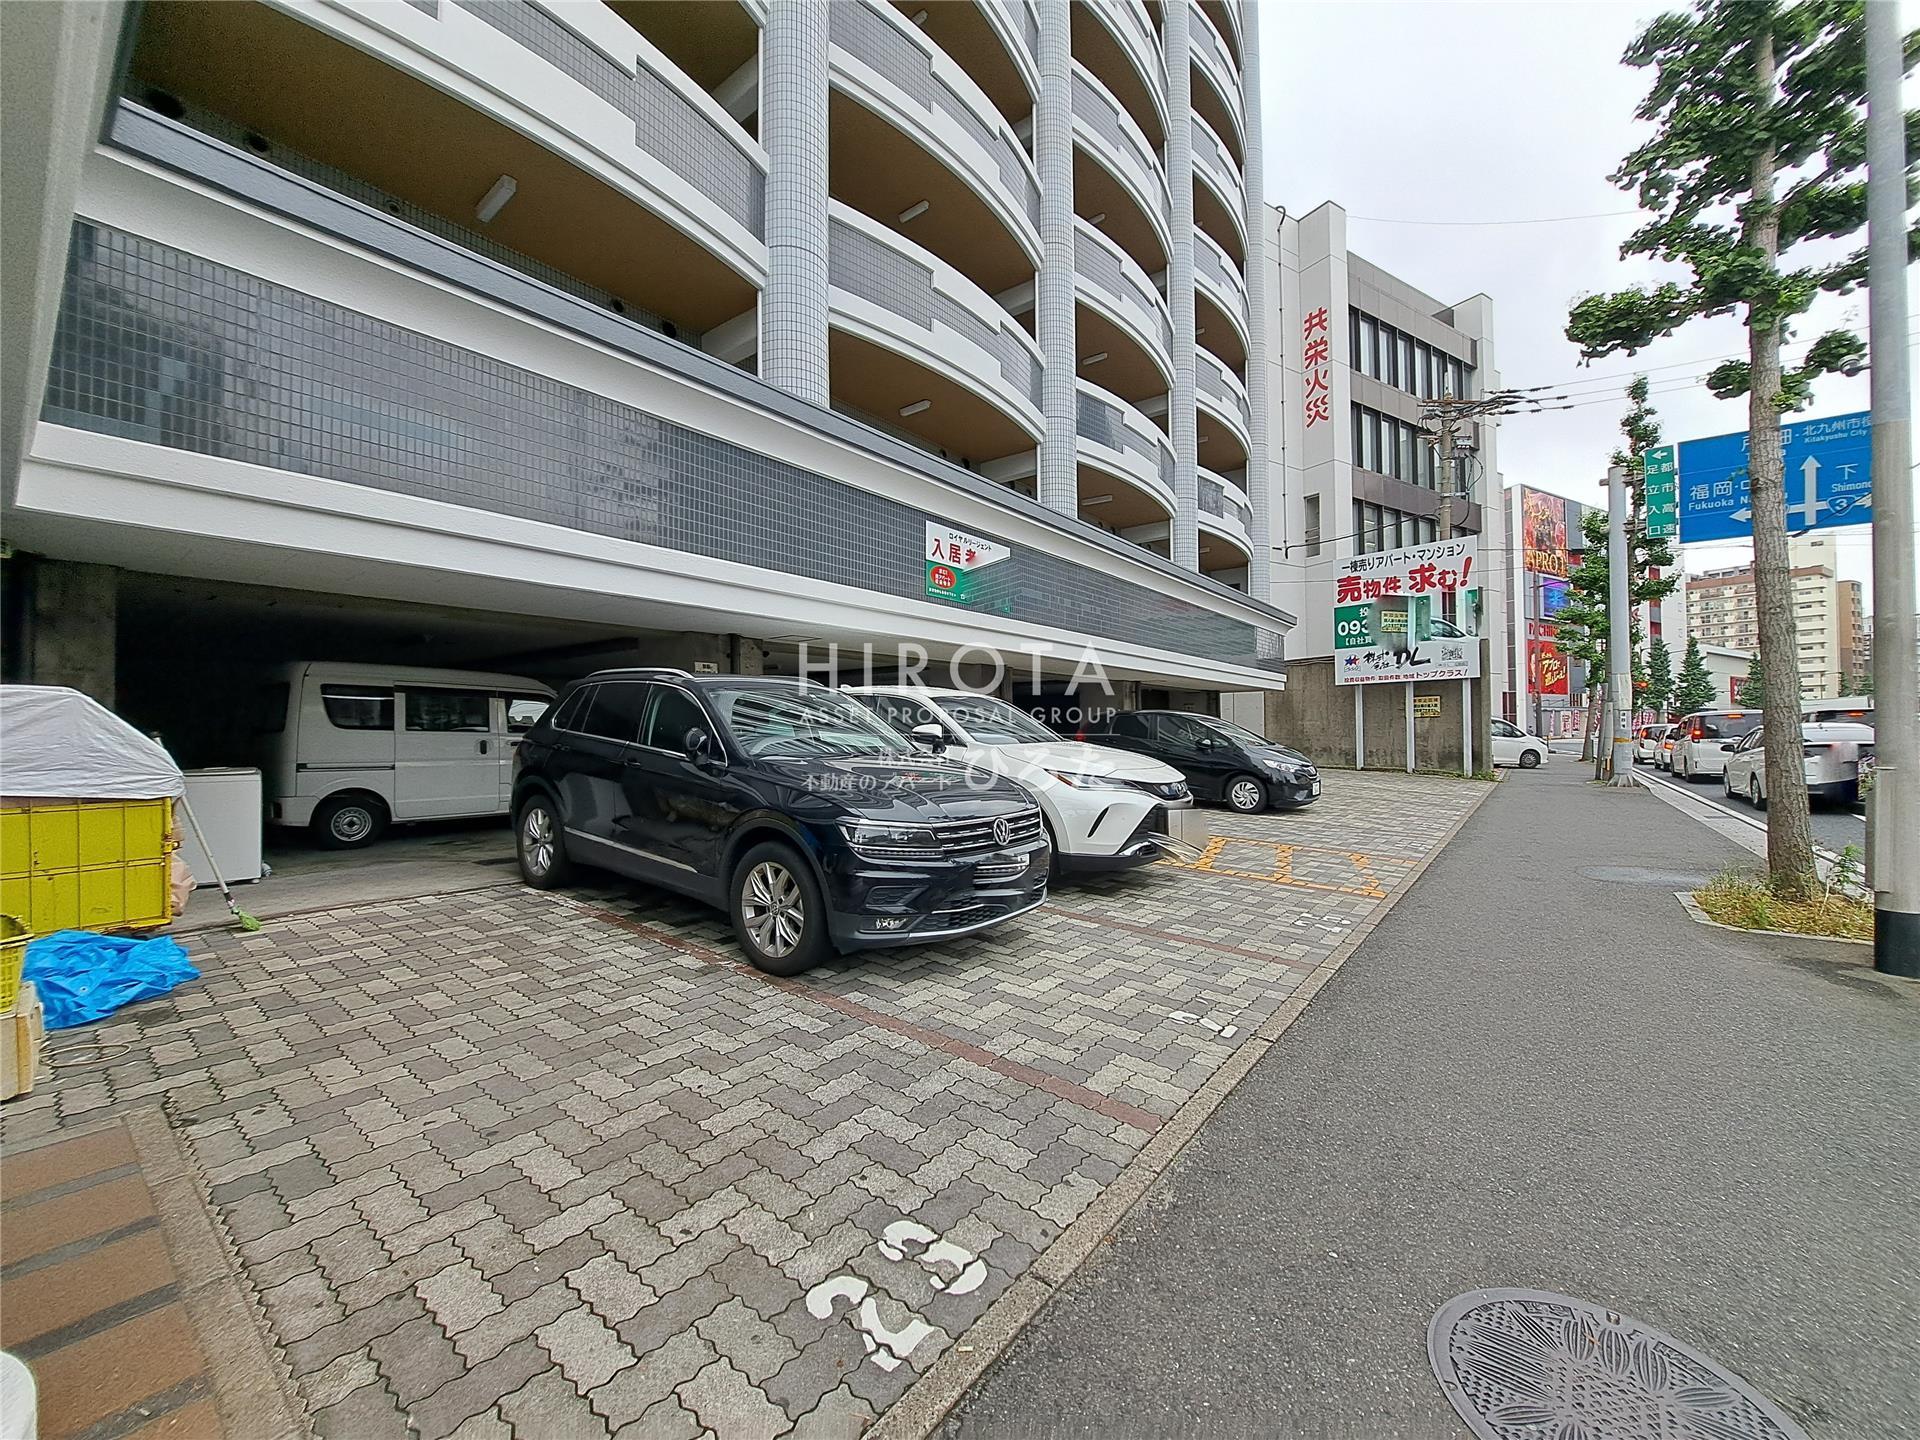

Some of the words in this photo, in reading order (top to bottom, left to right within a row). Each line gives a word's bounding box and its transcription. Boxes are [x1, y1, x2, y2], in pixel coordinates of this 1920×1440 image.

[1304, 306, 1329, 428] 共栄火災
[1804, 431, 1848, 443] Kitakyushu
[1850, 429, 1868, 437] City
[1646, 465, 1661, 536] 足立入口
[1661, 462, 1676, 534] 都市高速
[1688, 498, 1735, 512] Fukuoka
[1835, 499, 1848, 511] 3
[1337, 575, 1402, 604] 売物件
